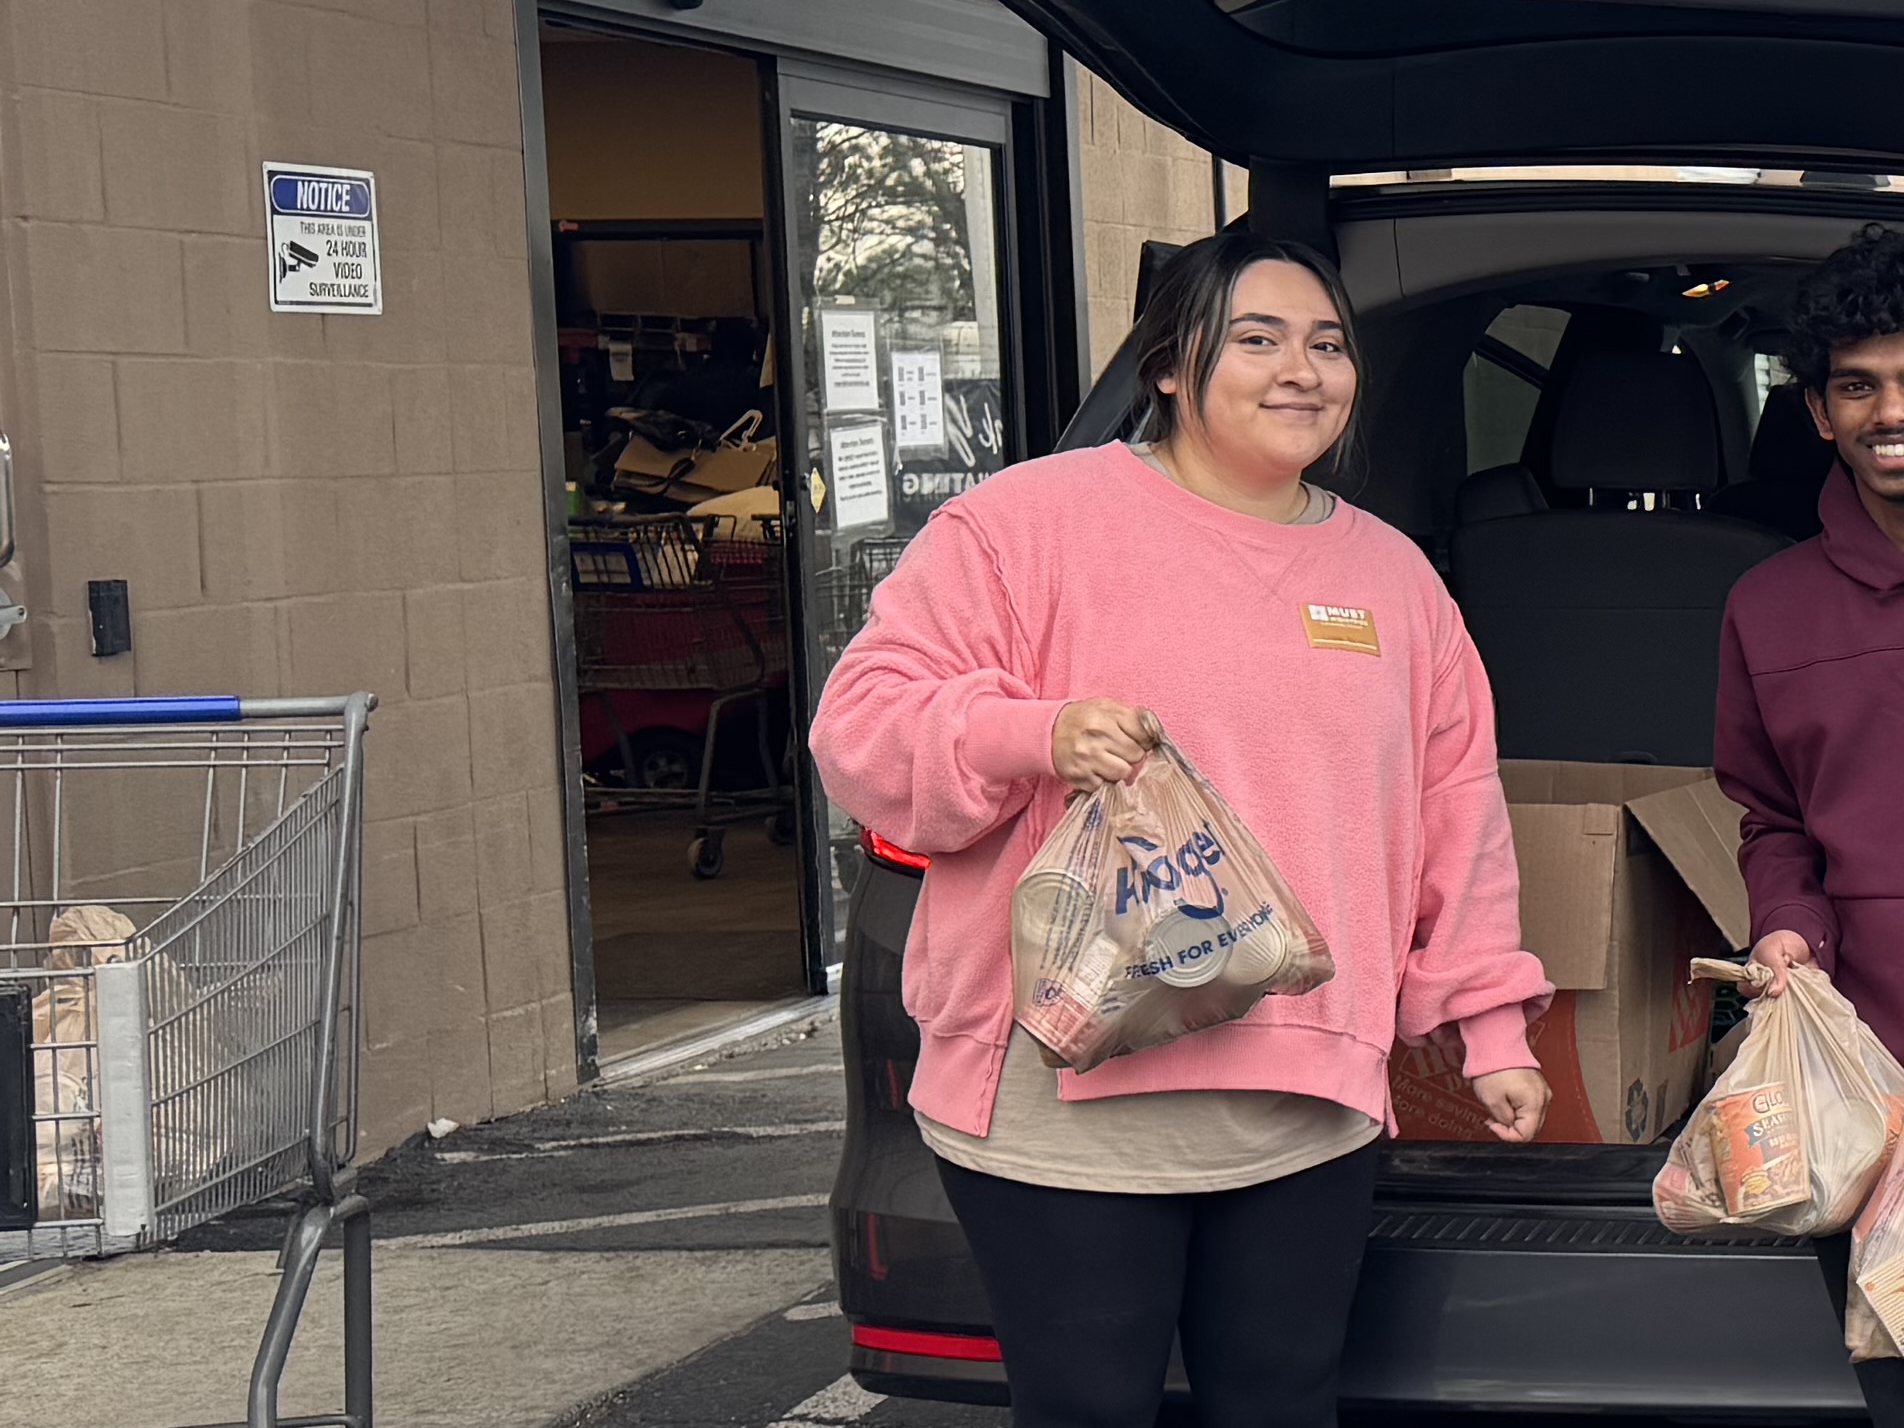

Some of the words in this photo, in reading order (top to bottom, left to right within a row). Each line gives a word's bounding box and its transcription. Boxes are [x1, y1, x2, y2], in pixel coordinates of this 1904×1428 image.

[297, 181, 350, 212] NOTICE
[300, 222, 315, 234] THIS
[317, 223, 335, 236] AREA
[337, 225, 343, 236] IS
[345, 225, 365, 237] UNDER
[326, 240, 338, 256] 24
[342, 241, 367, 258] HOUR
[333, 263, 362, 279] VIDEO
[310, 282, 368, 297] SURVEILLANCE
[1125, 957, 1174, 981] FRESH
[1178, 940, 1214, 965] FOR
[1217, 901, 1273, 947] EVERYONE
